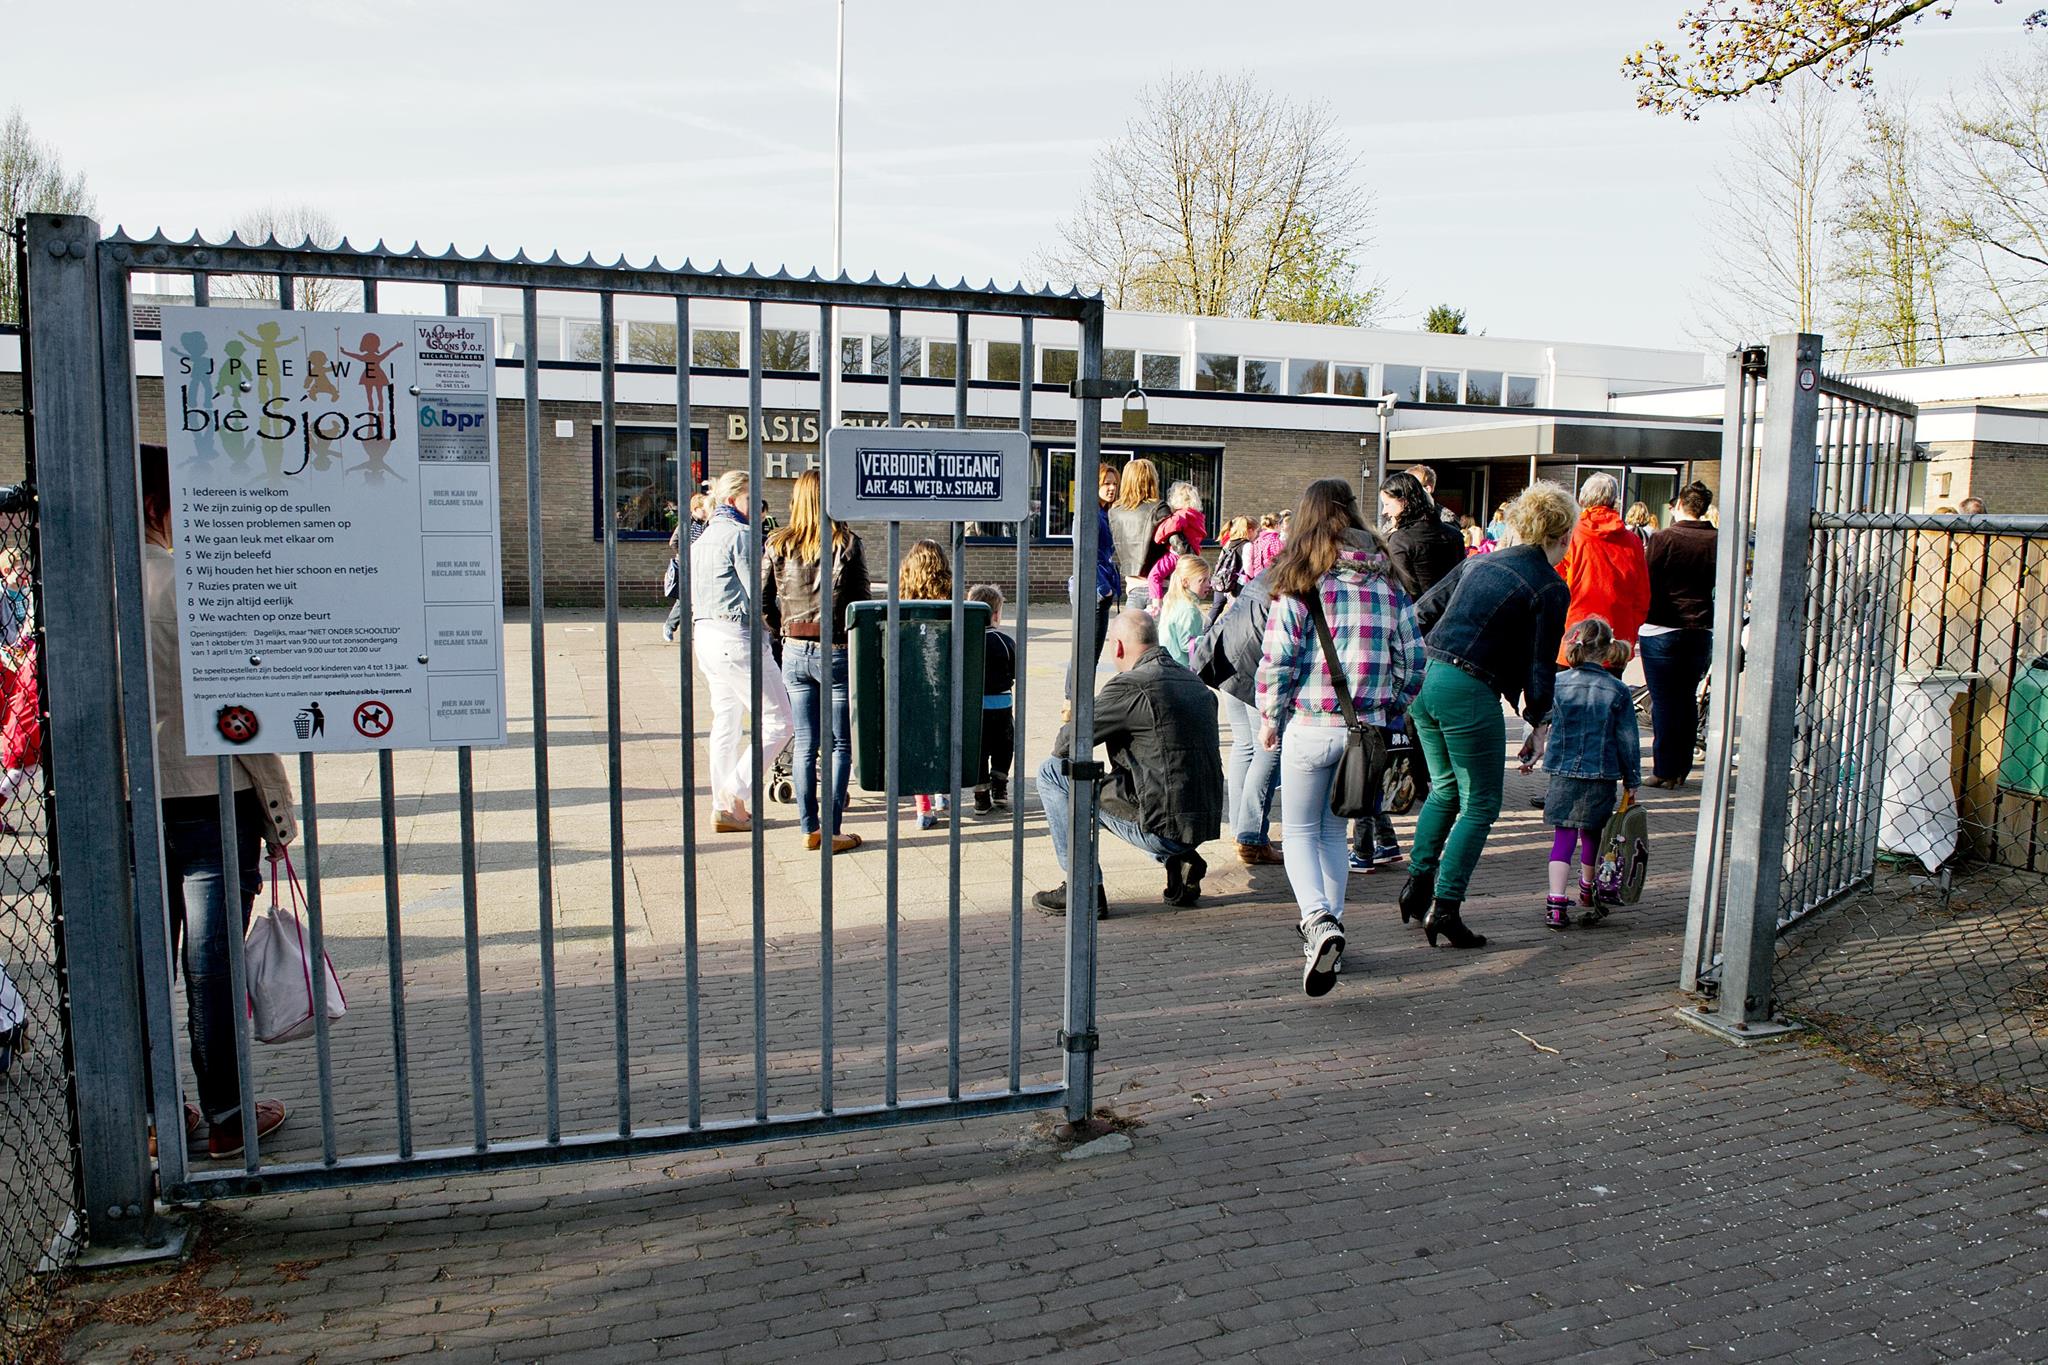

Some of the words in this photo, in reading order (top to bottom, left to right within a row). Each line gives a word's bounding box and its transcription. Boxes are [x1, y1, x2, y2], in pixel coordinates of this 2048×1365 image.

[441, 409, 485, 432] bpr
[861, 453, 936, 477] VERBODEN
[938, 455, 999, 478] TOEGANG
[182, 488, 187, 496] 1
[193, 488, 237, 497] Iedereen
[239, 488, 247, 497] is
[249, 487, 289, 497] welkom
[182, 504, 189, 512] 2
[193, 504, 209, 512] We
[211, 504, 229, 514] zijn
[231, 504, 262, 514] zuinig
[264, 504, 278, 514] op
[280, 503, 293, 512] de
[295, 504, 331, 514] spullen
[183, 520, 190, 528] 3
[194, 520, 210, 528] We
[212, 519, 244, 528] lossen
[246, 519, 301, 529] problemen
[303, 520, 335, 528] samen
[337, 520, 351, 529] op
[184, 535, 190, 544] 4
[195, 535, 211, 544] We
[213, 536, 238, 545] gaan
[240, 535, 262, 544] leuk
[263, 536, 283, 544] met
[285, 535, 315, 544] elkaar
[317, 536, 334, 544] om
[185, 551, 192, 559] 5
[196, 551, 212, 559] We
[214, 550, 232, 561] zijn
[234, 550, 271, 559] beleefd
[186, 566, 192, 575] 6
[197, 566, 213, 577] Wij
[215, 566, 254, 575] houden
[256, 566, 272, 575] het
[275, 565, 294, 574] hier
[296, 565, 331, 574] schoon
[349, 565, 379, 576] netjes
[187, 582, 193, 591] 7
[198, 582, 230, 591] Ruzies
[232, 582, 265, 592] praten
[267, 582, 282, 590] we
[284, 581, 297, 590] uit
[188, 598, 194, 607] 8
[199, 598, 215, 606] We
[217, 597, 234, 608] zijn
[236, 597, 261, 607] altijd
[263, 596, 294, 607] eerlijk
[188, 613, 195, 622] 9
[200, 613, 216, 621] We
[217, 612, 260, 621] wachten
[262, 613, 276, 623] op
[278, 613, 302, 621] onze
[304, 612, 331, 620] beurt
[254, 648, 292, 656] september
[192, 667, 203, 675] De
[204, 666, 258, 675] speeltoestellen
[273, 665, 302, 673] bedoeld
